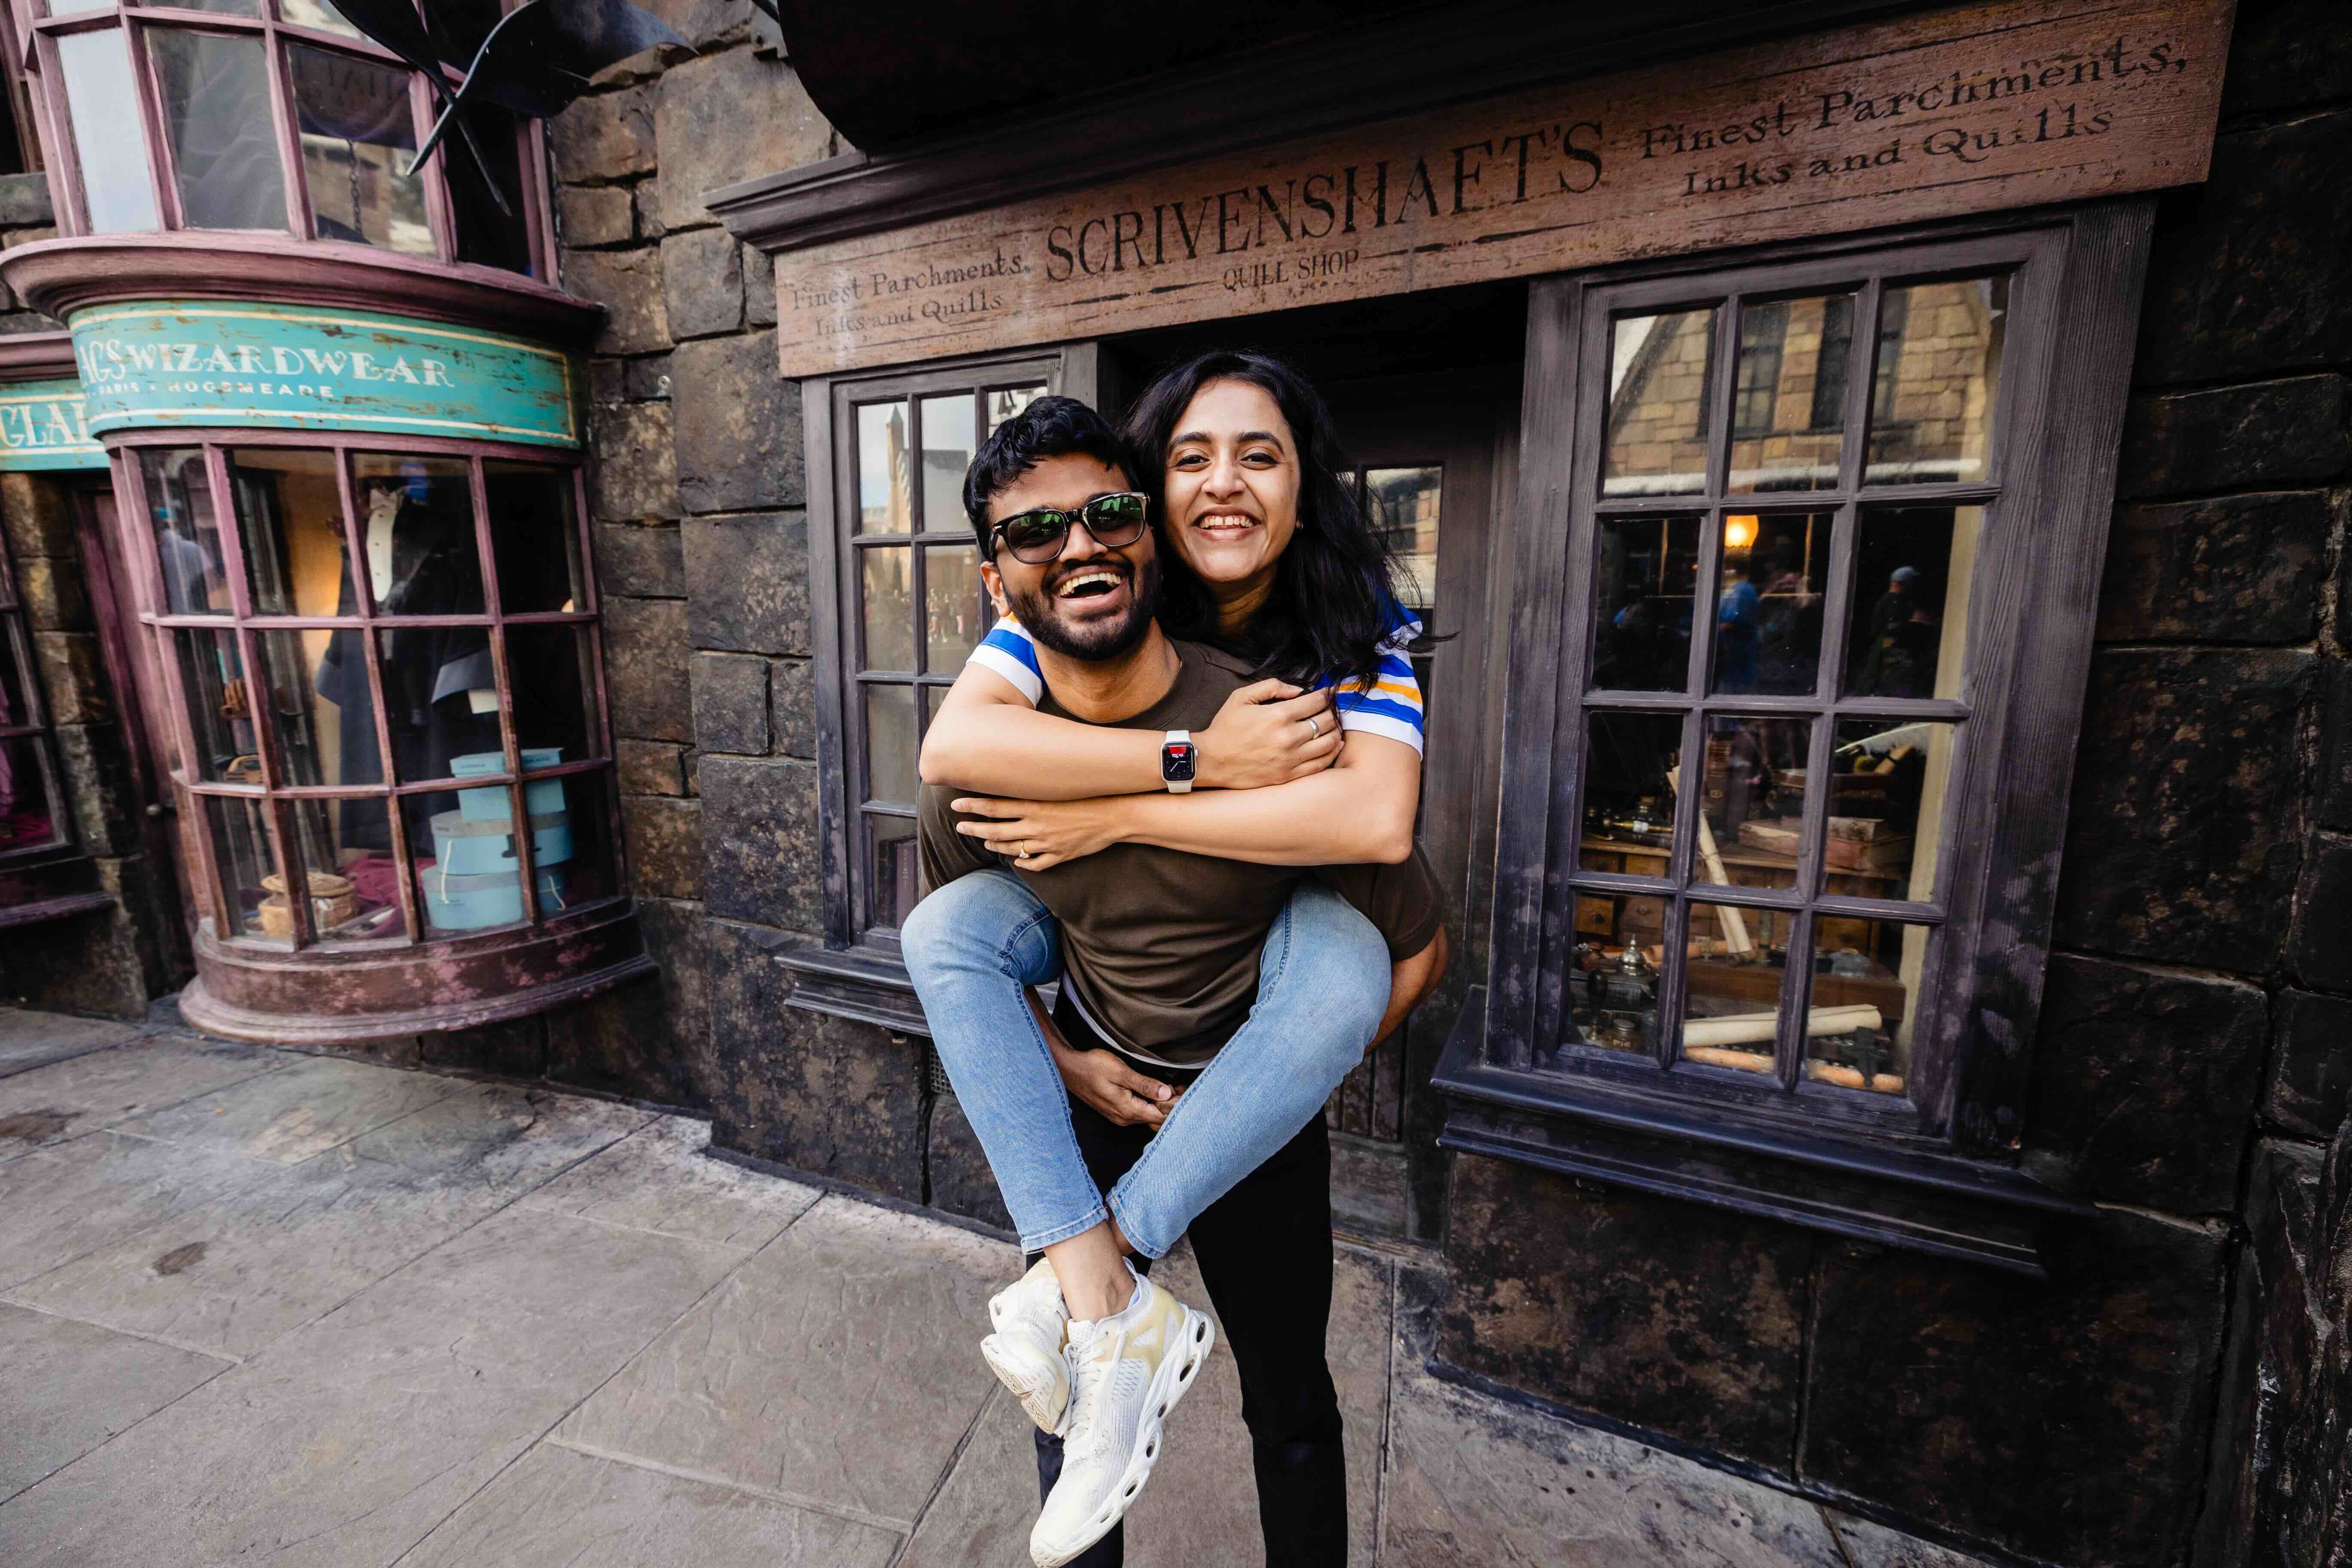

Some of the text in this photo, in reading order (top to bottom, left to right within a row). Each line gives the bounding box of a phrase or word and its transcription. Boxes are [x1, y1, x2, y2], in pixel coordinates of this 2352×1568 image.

[1641, 34, 2187, 160] Finest Parchments,
[1679, 101, 2114, 198] Inks and Quills
[1046, 121, 1603, 282] SCRIVENSHAFT'S
[793, 276, 864, 311] Finest
[1223, 248, 1359, 292] QUILL SHOP
[816, 288, 1004, 337] Inks and Quills
[125, 343, 455, 388] WIZARDWEAR
[168, 381, 334, 398] HOGSMEADE
